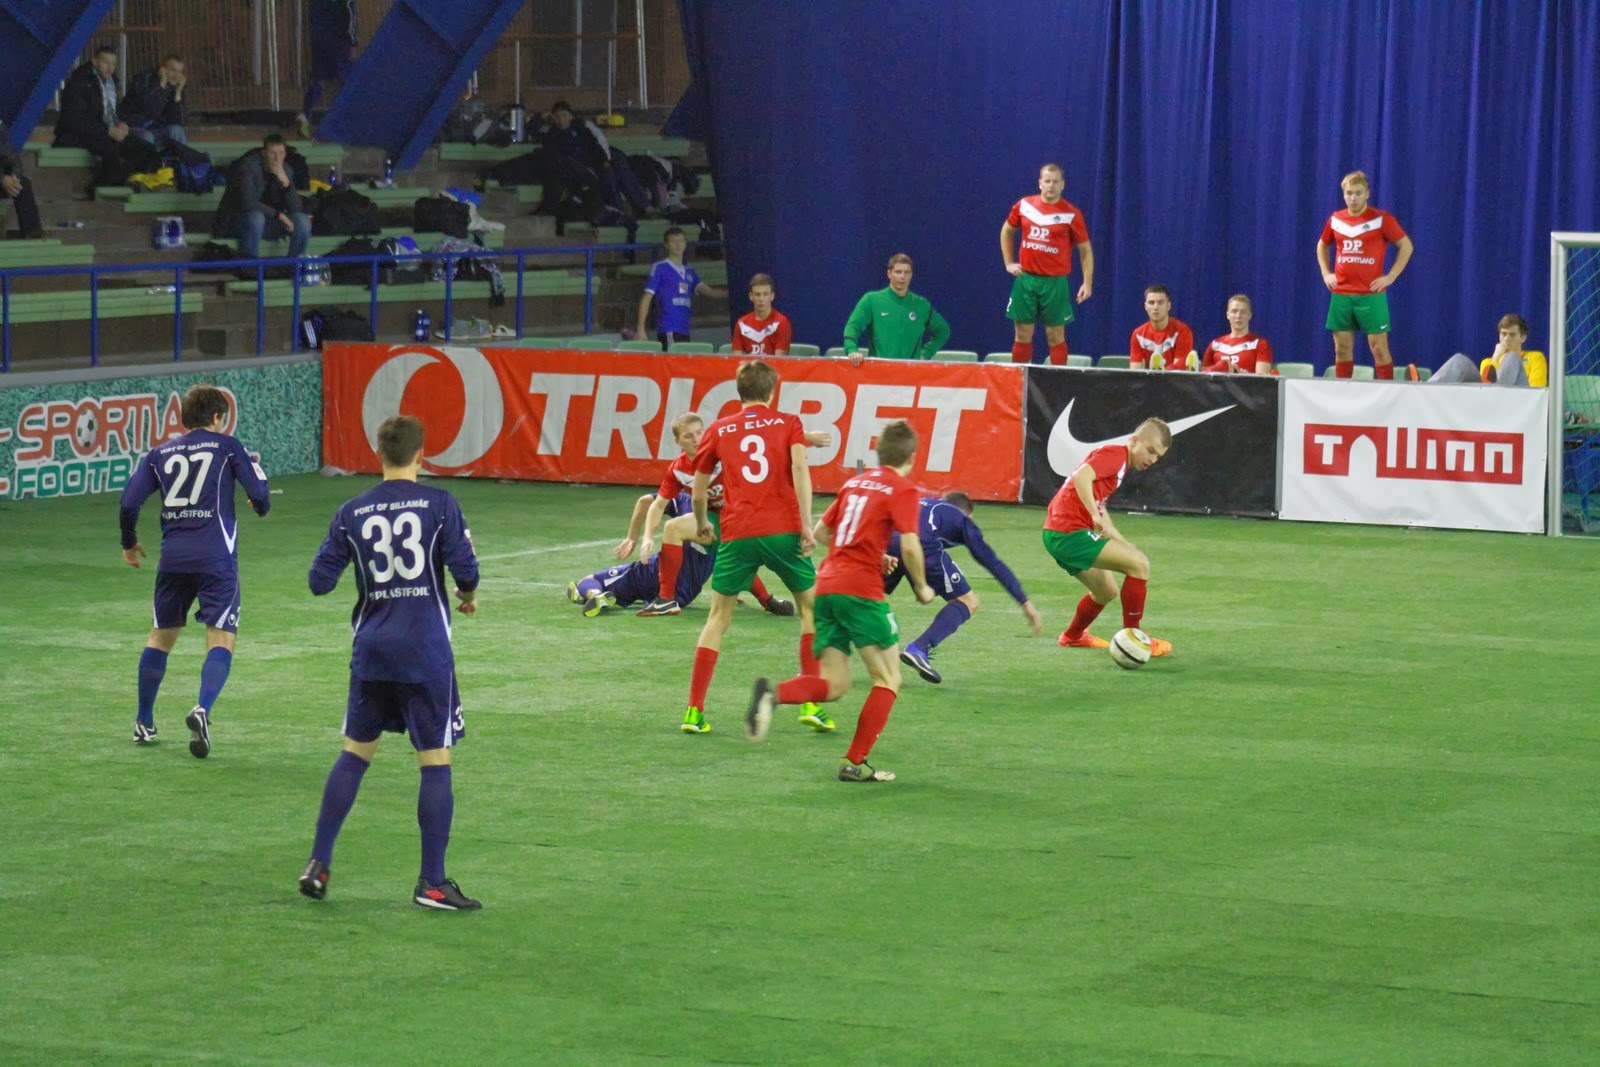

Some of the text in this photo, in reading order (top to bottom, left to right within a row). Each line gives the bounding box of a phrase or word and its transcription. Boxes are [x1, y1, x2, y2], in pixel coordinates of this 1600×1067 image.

[1027, 226, 1050, 239] DP
[1342, 239, 1363, 251] DP
[16, 388, 237, 463] SPORTLA
[718, 417, 785, 437] FC ELVA
[15, 455, 148, 498] FOOTB
[164, 452, 214, 507] 27
[740, 434, 769, 484] 3
[354, 504, 375, 517] PORT
[376, 502, 388, 512] OF
[835, 494, 869, 547] 11
[361, 512, 426, 584] 33
[374, 586, 430, 600] PLASTFOIL
